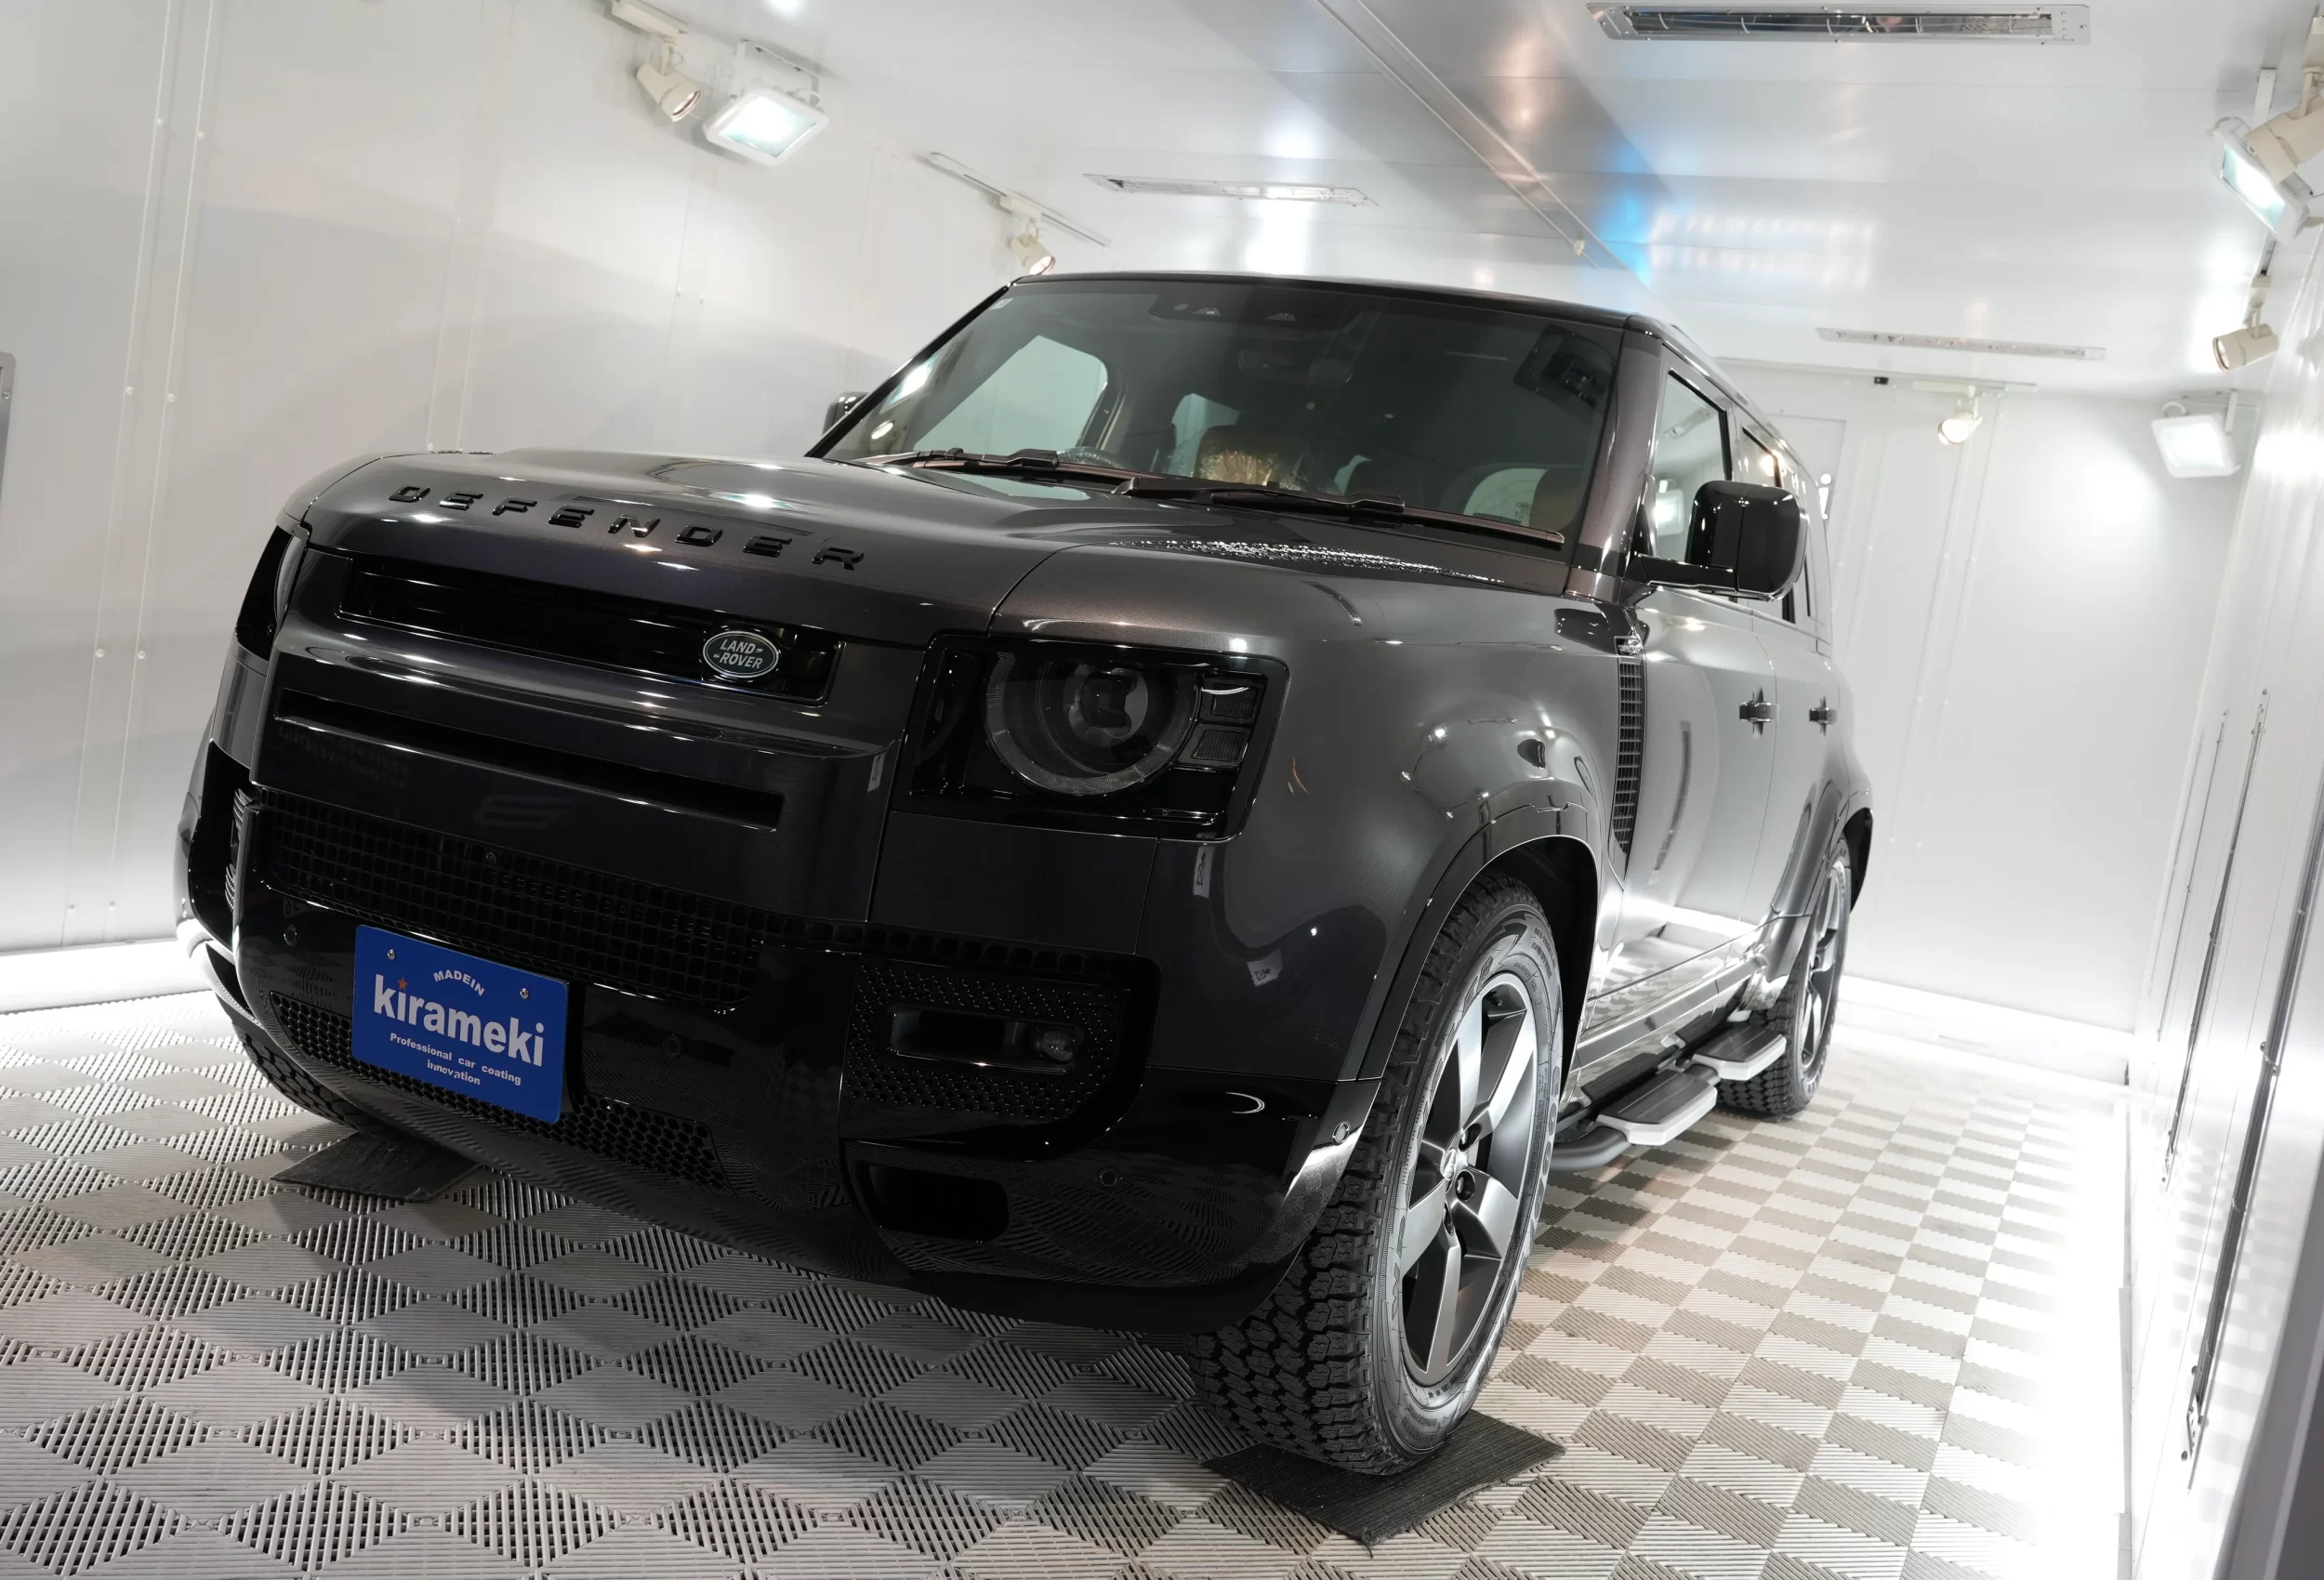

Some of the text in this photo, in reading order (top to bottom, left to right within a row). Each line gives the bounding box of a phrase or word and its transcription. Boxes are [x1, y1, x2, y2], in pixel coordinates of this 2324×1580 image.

[389, 485, 865, 570] DEFENDER
[720, 639, 756, 654] LAND
[720, 652, 763, 669] ROVER
[374, 973, 544, 1067] kirameki
[390, 1033, 522, 1086] Professional car coating
[427, 1060, 481, 1086] innovation
